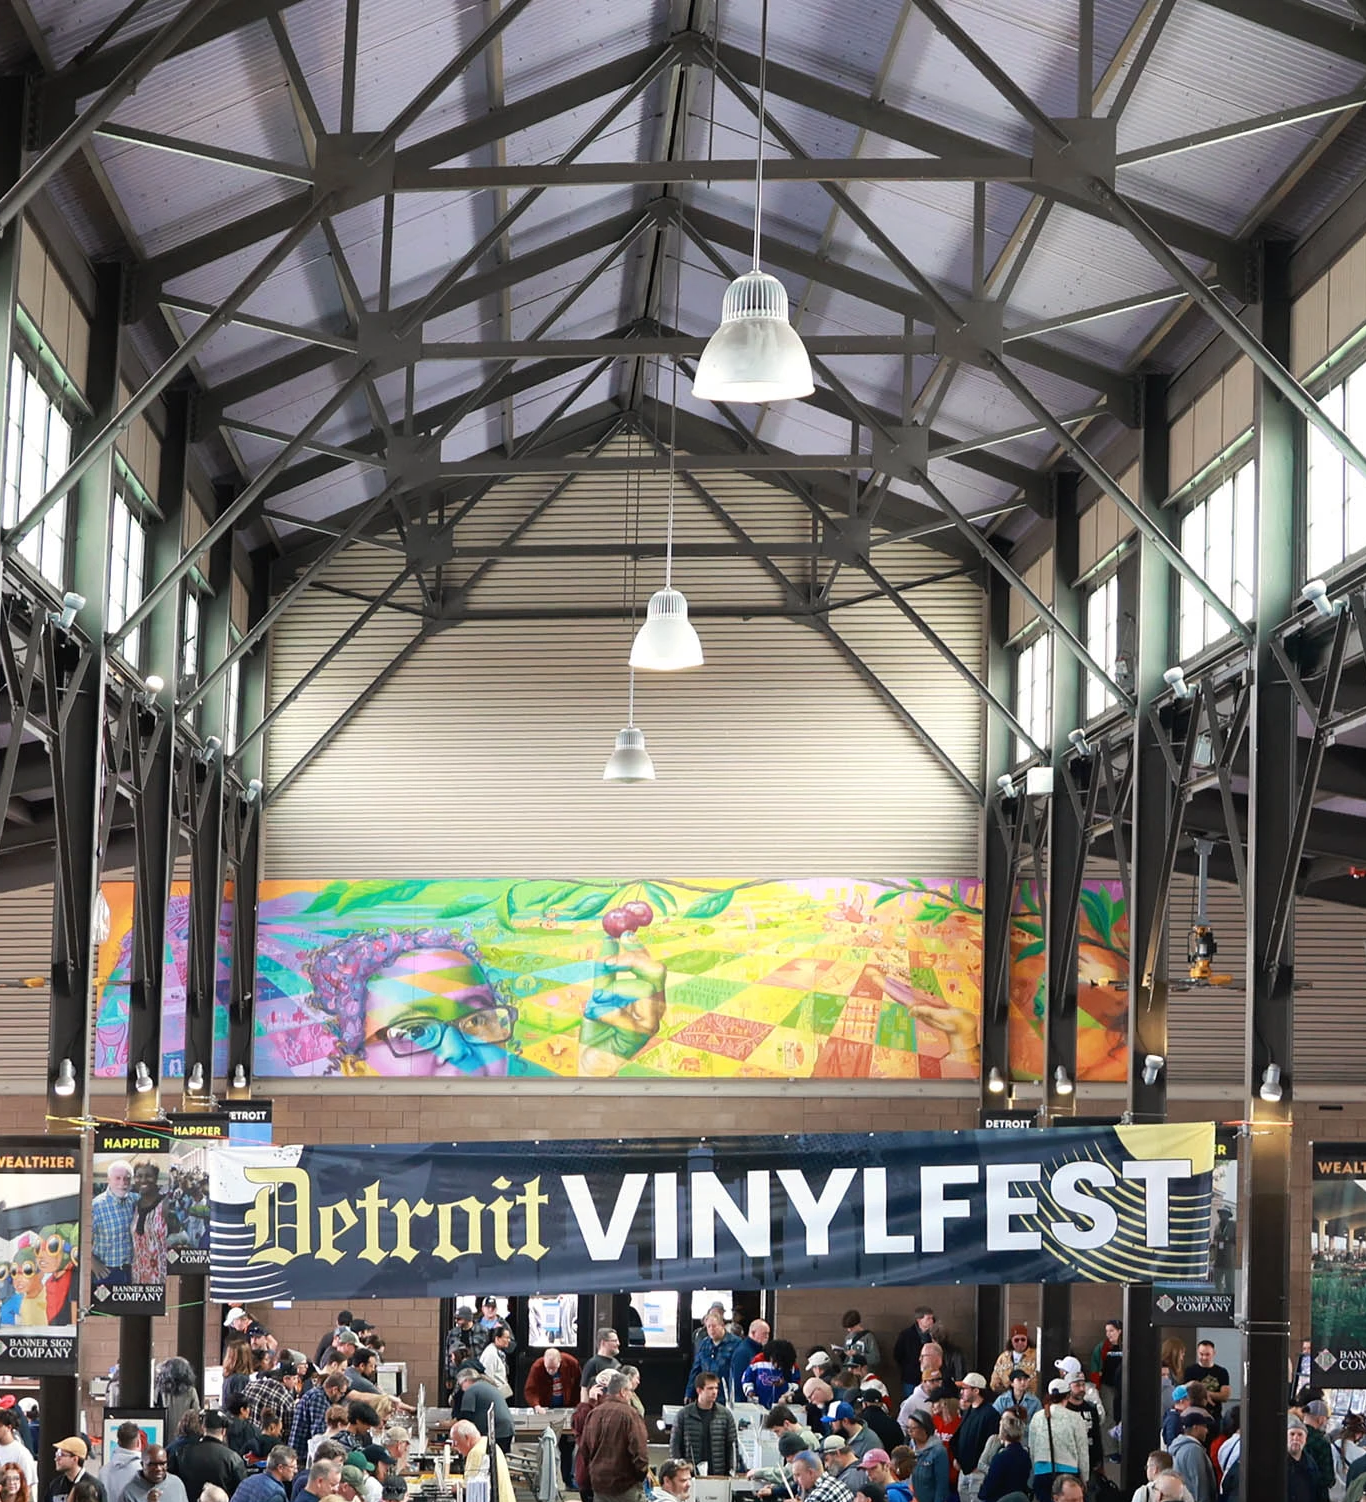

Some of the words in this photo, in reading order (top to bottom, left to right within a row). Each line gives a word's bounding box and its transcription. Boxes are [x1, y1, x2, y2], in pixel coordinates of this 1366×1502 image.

[229, 1110, 268, 1121] ETROIT
[985, 1119, 1031, 1129] DETROIT
[173, 1125, 222, 1138] HAPPIER
[103, 1137, 161, 1150] HAPPIER
[243, 1166, 551, 1267] Detroit
[559, 1159, 1193, 1261] VINYLFEST
[180, 1256, 211, 1264] COMPA
[112, 1285, 144, 1293] BANNER
[145, 1285, 164, 1293] SIGN
[112, 1292, 163, 1302] COMPANY
[1176, 1295, 1211, 1303] BANNER
[1213, 1295, 1232, 1304] SIGN
[1176, 1302, 1231, 1312] COMPANY
[9, 1338, 49, 1347] BANNER
[50, 1339, 73, 1348] SIGN
[9, 1347, 71, 1359] COMPANY
